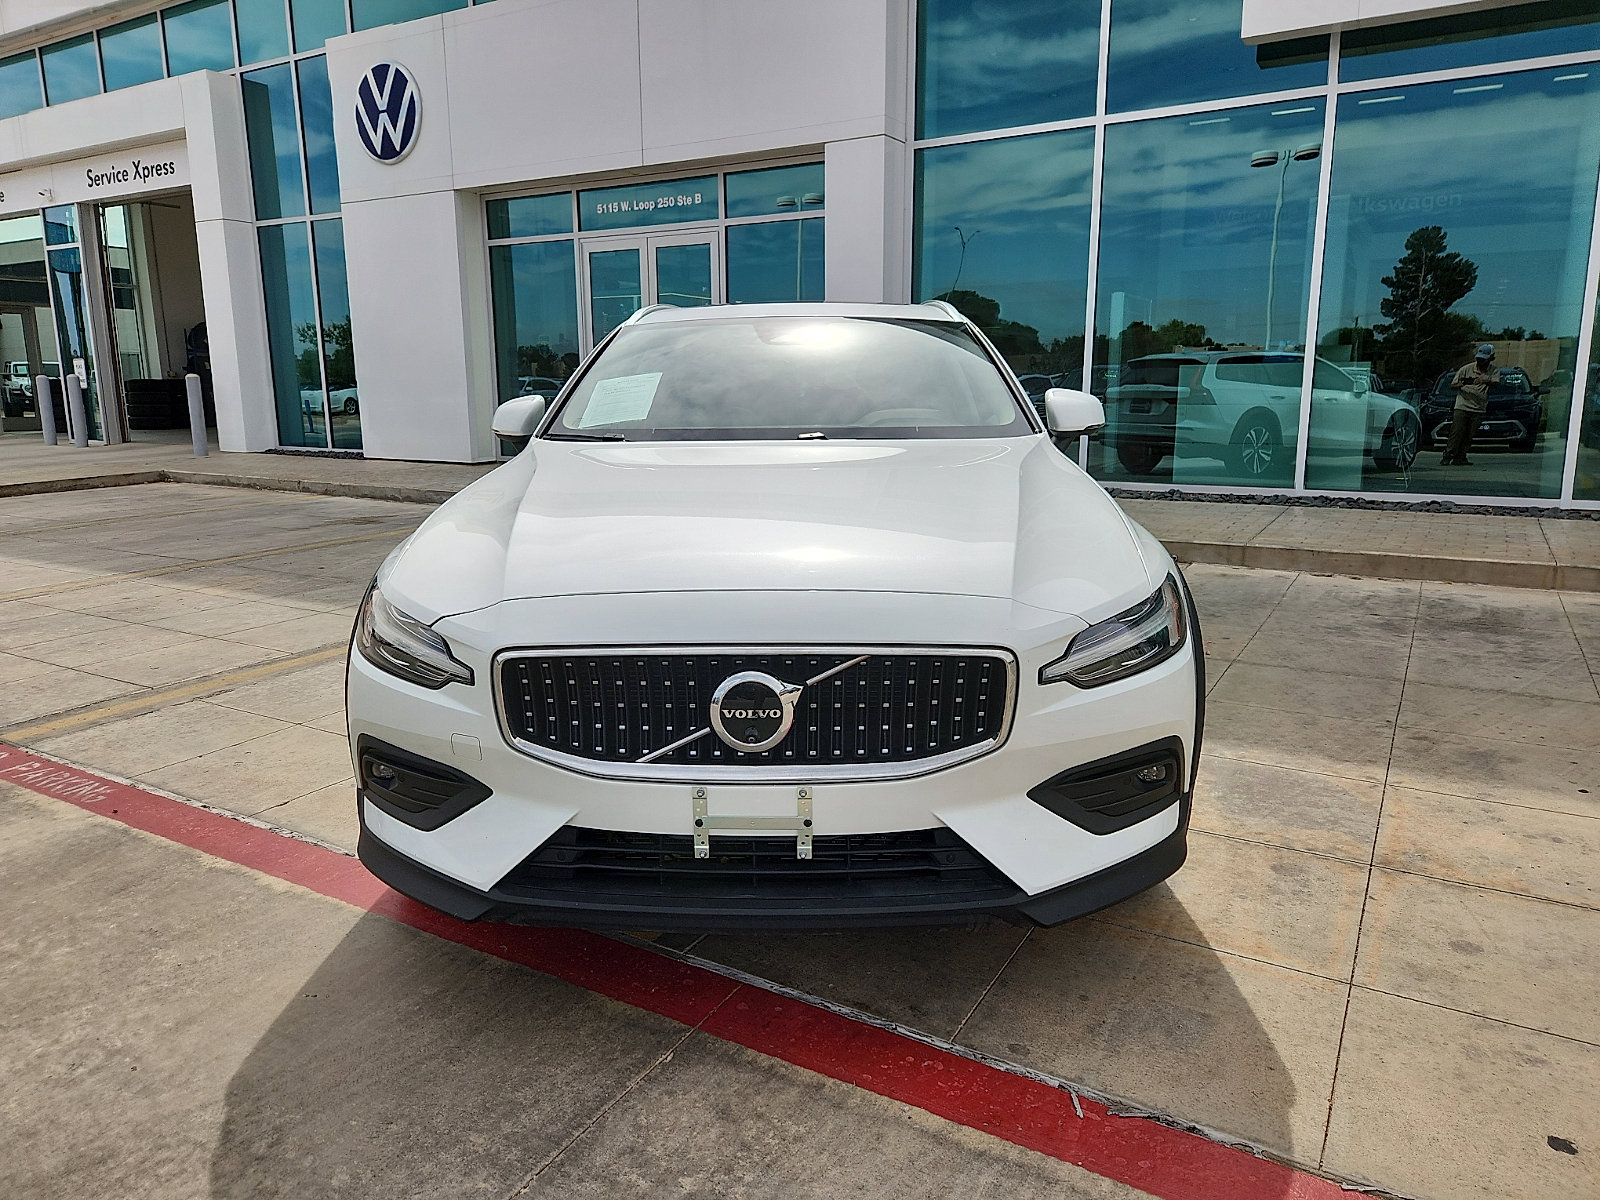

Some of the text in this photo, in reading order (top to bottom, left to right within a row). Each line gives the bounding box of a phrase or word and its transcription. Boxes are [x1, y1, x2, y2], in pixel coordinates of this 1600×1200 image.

[355, 61, 417, 160] VW
[86, 160, 175, 188] Service Xpress
[597, 193, 702, 214] 5115 W. Loop 250 Ste B
[721, 709, 781, 719] VOLVO
[0, 761, 119, 803] PARKING
